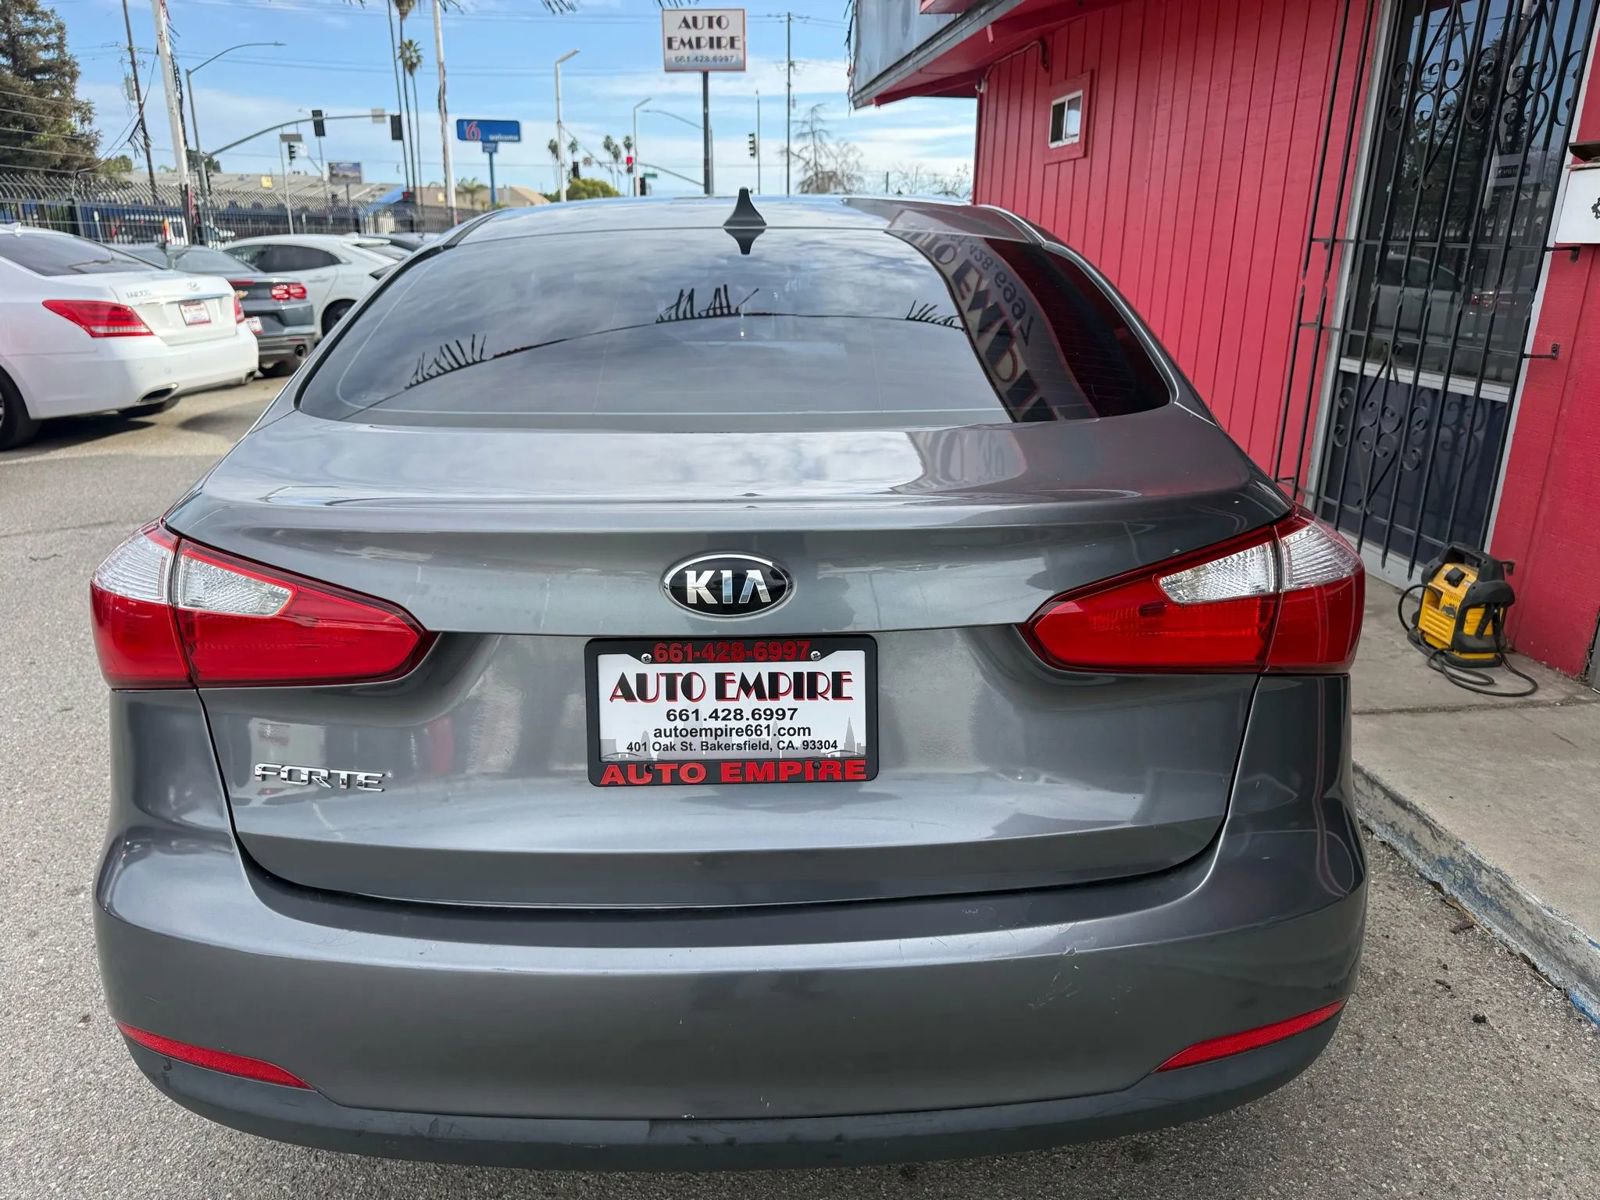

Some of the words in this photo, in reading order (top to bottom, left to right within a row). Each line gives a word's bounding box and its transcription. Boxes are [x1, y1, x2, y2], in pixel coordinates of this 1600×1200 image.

[678, 15, 730, 30] AUTO
[666, 35, 742, 51] EMPIRE
[685, 569, 772, 604] KIA
[654, 641, 811, 663] 661-428-6997
[609, 671, 707, 703] AUTO
[714, 671, 854, 702] EMPIRE
[666, 707, 799, 722] 661.428.6997
[653, 724, 812, 740] autoempire661.com
[626, 742, 648, 753] 401
[652, 741, 677, 752] Oak
[680, 741, 696, 752] St.
[702, 740, 773, 753] Bakersfield,
[777, 740, 799, 751] CA.
[802, 739, 839, 751] 93304
[254, 763, 385, 792] FORTE
[600, 763, 708, 786] AUTO
[720, 759, 867, 783] EMPIRE
